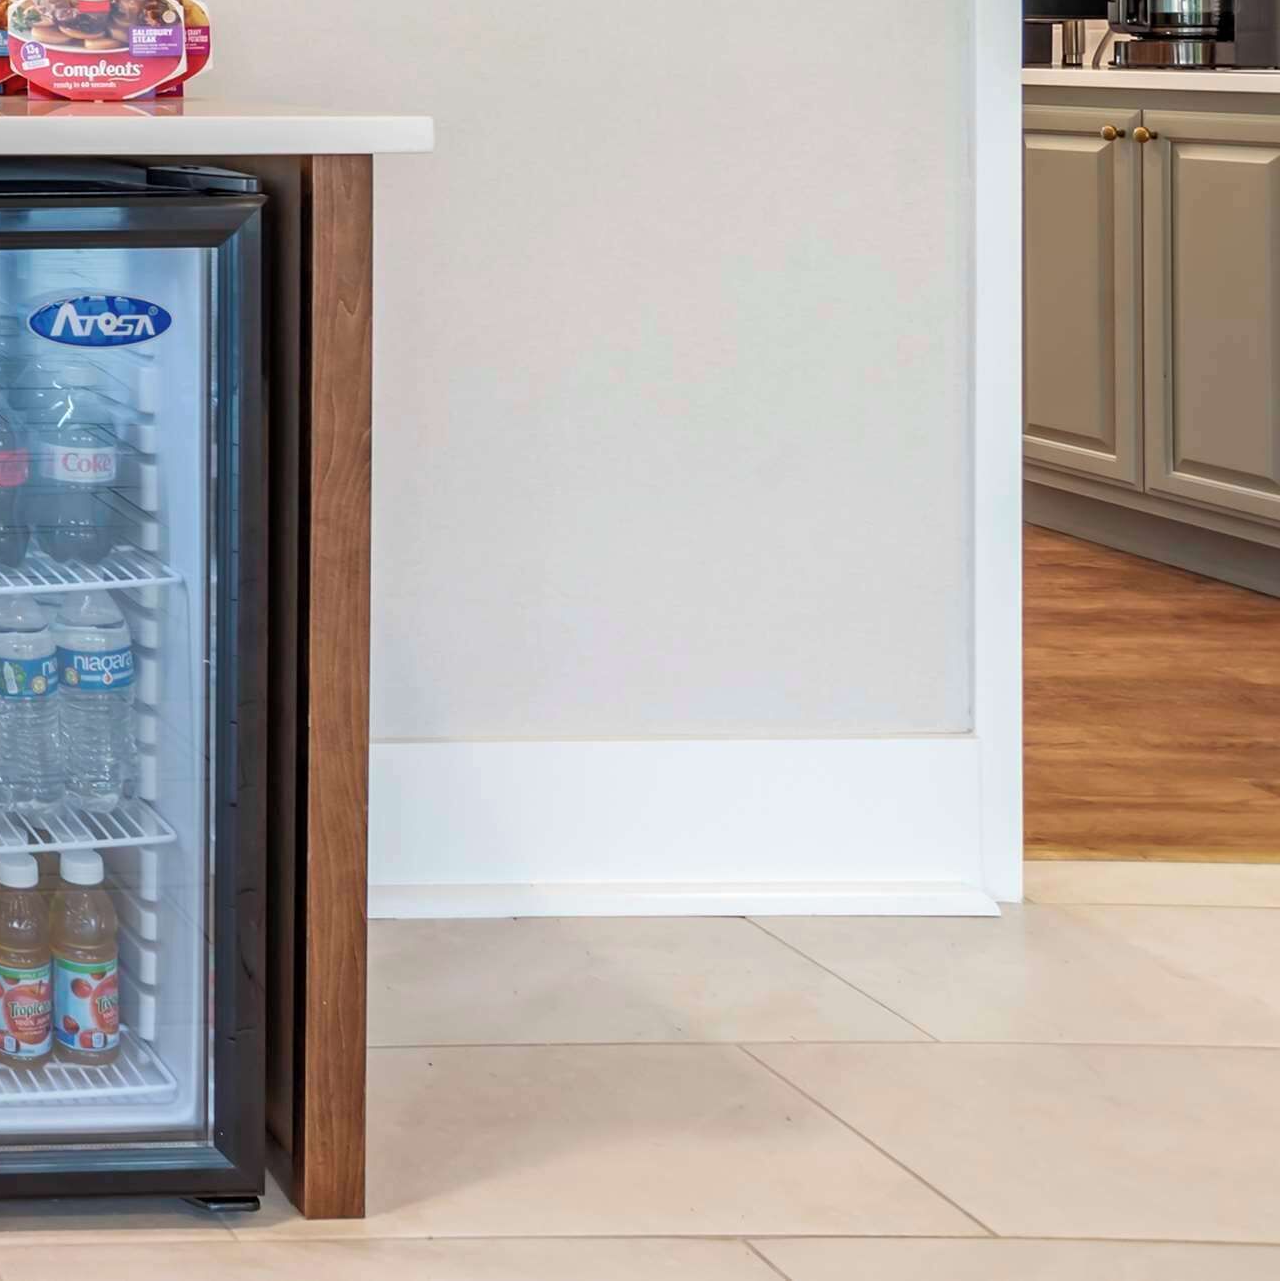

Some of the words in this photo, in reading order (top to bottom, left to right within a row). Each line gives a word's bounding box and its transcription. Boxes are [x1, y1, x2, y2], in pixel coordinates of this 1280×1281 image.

[132, 35, 157, 43] STEAK
[52, 60, 141, 81] Compleats
[49, 302, 156, 337] ATOSA
[61, 452, 112, 473] Coke
[73, 650, 134, 673] niagara
